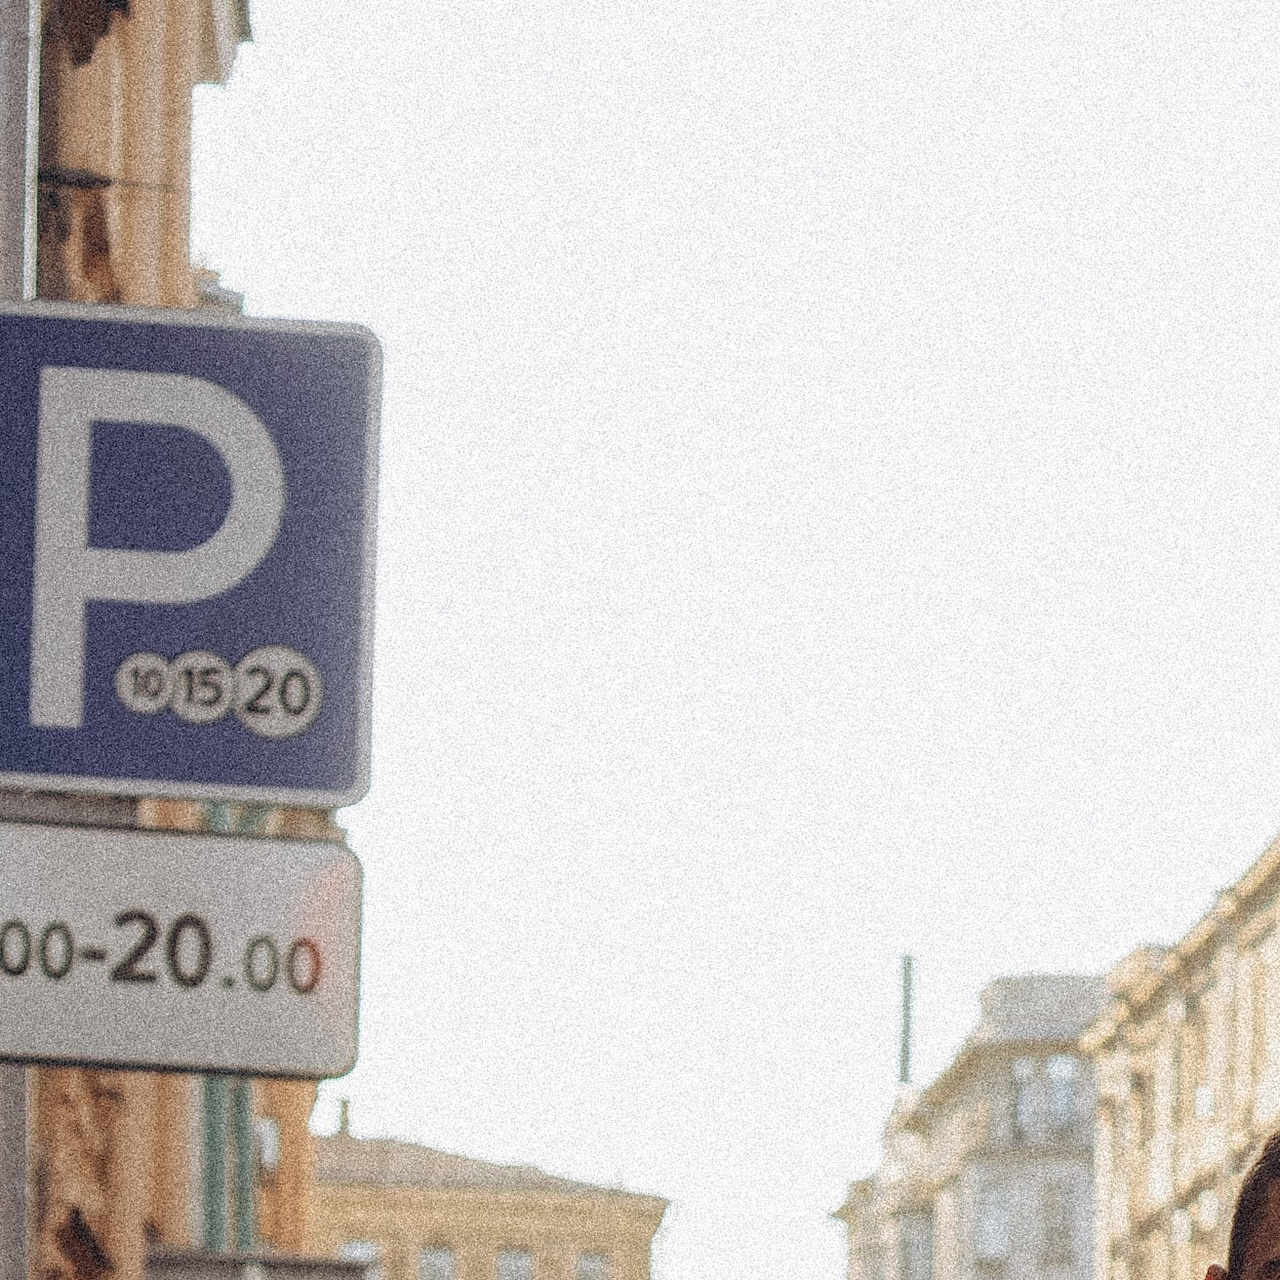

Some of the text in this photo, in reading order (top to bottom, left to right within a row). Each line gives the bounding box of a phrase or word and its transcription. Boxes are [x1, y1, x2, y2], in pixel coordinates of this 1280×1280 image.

[30, 366, 285, 729] P
[130, 665, 310, 716] 10 15 20
